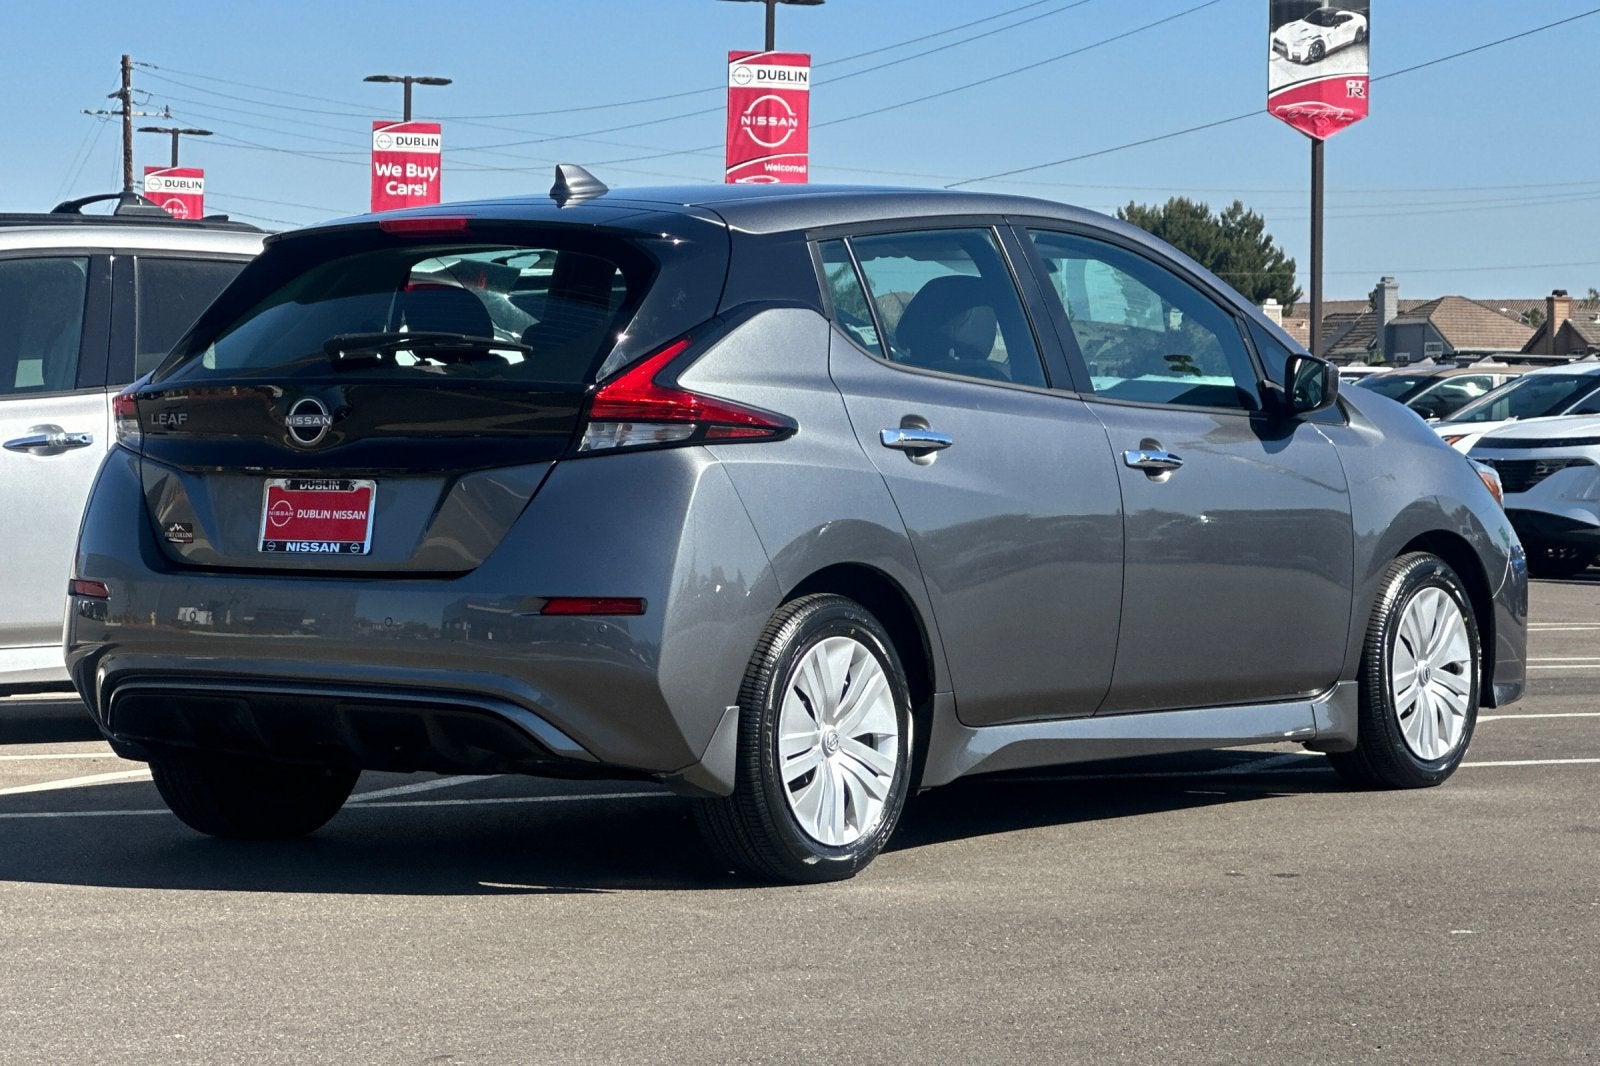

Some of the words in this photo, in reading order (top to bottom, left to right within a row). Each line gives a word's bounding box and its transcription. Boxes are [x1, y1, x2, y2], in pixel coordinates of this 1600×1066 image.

[757, 69, 808, 82] DUBLIN
[741, 116, 798, 127] NISSAN
[396, 136, 439, 147] DUBLIN
[375, 162, 402, 177] We
[406, 163, 438, 182] Buy
[764, 162, 806, 173] Welcome!
[164, 179, 202, 189] DUBLIN
[385, 181, 427, 196] Cars!
[151, 413, 187, 425] LEAF
[285, 416, 331, 425] NISSAN
[300, 480, 340, 490] DUBLIN
[297, 509, 331, 519] DUBLIN
[332, 510, 366, 520] NISSAN
[286, 542, 340, 553] NISSAN
